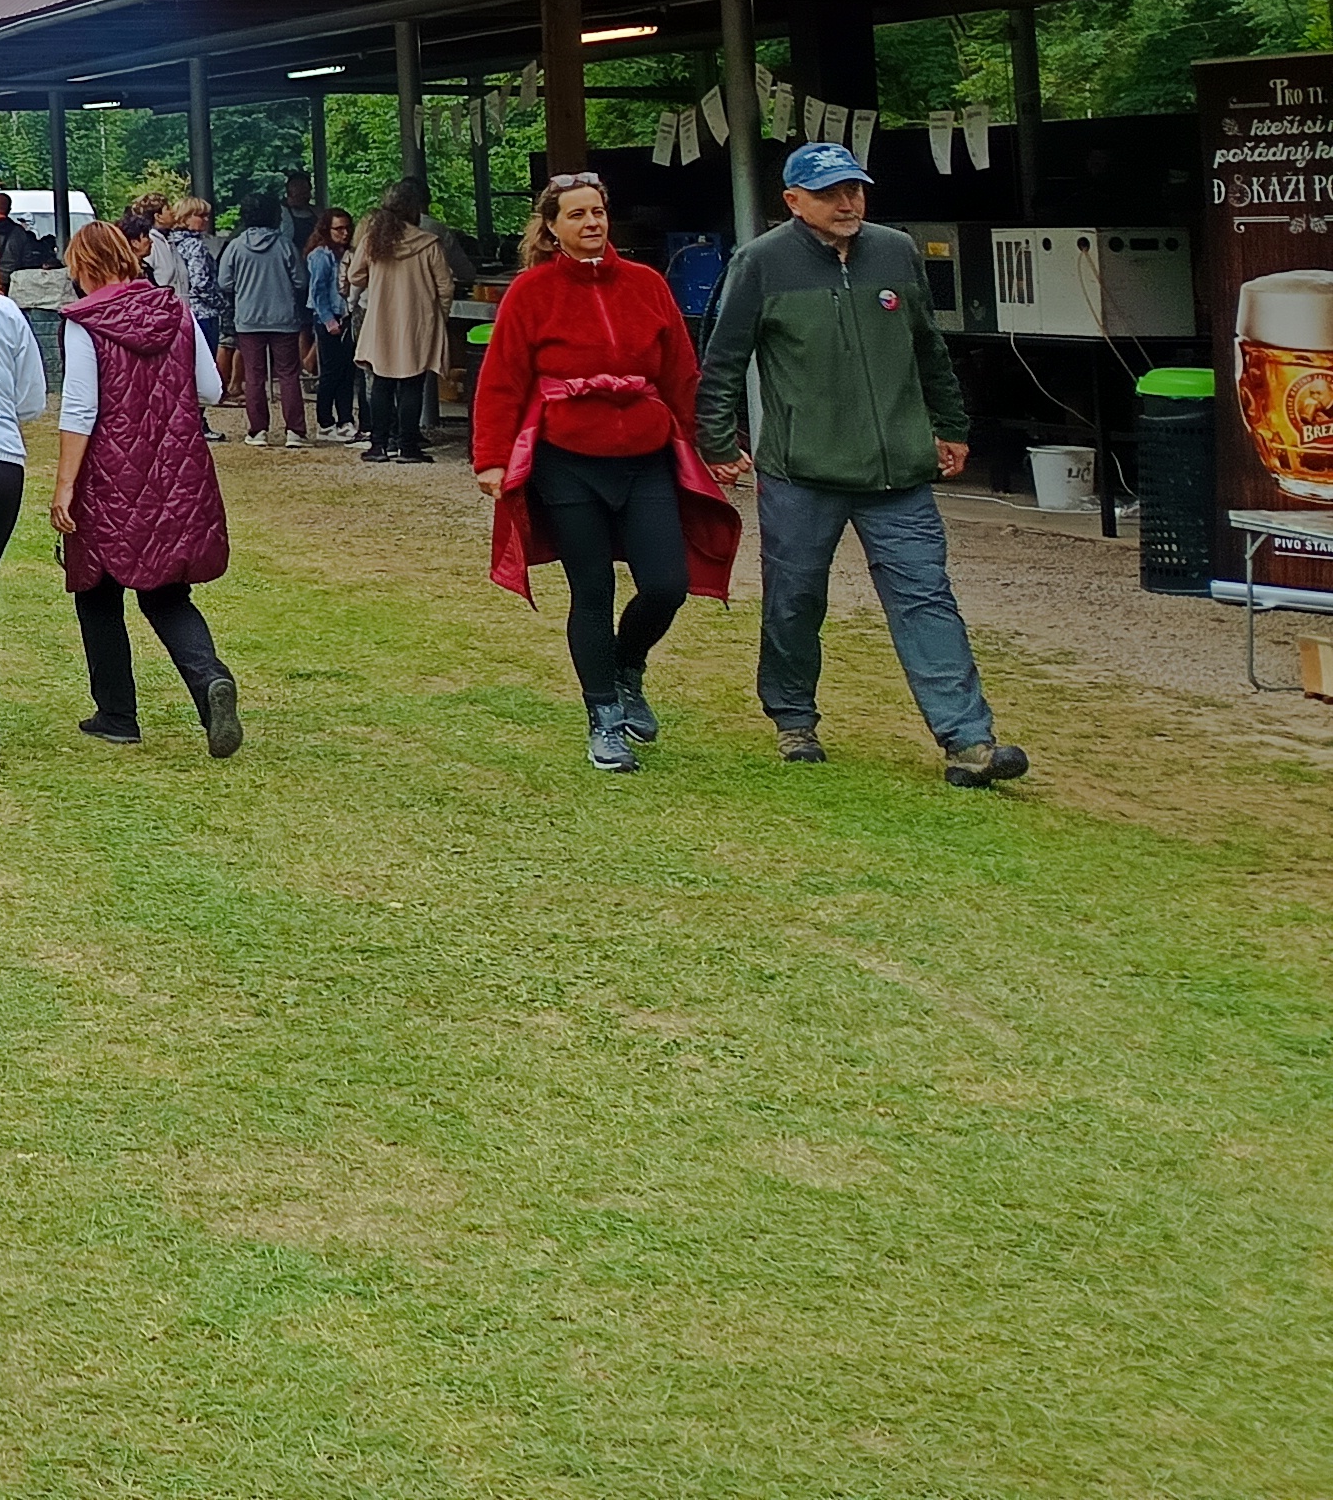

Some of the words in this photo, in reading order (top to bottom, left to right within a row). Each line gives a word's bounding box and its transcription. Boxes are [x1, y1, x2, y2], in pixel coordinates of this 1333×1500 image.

[1250, 116, 1302, 136] kteří
[1213, 141, 1313, 169] pořádný
[1274, 537, 1302, 550] PIVO
